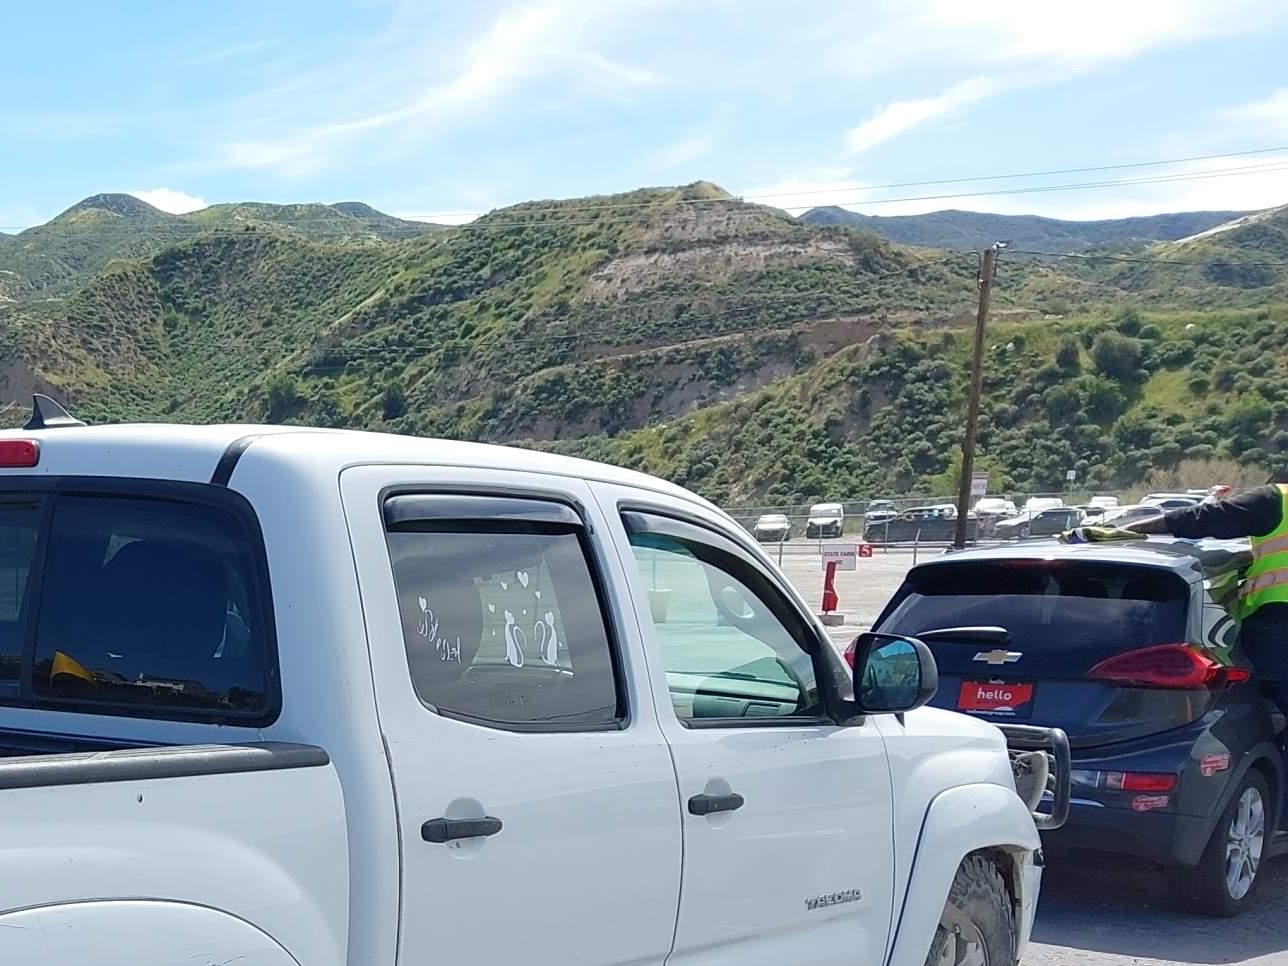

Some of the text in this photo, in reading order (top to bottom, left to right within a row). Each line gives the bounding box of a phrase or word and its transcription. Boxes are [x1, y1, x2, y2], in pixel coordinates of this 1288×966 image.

[861, 545, 870, 557] 5
[977, 687, 1012, 701] hello
[804, 889, 862, 910] TACOMA
